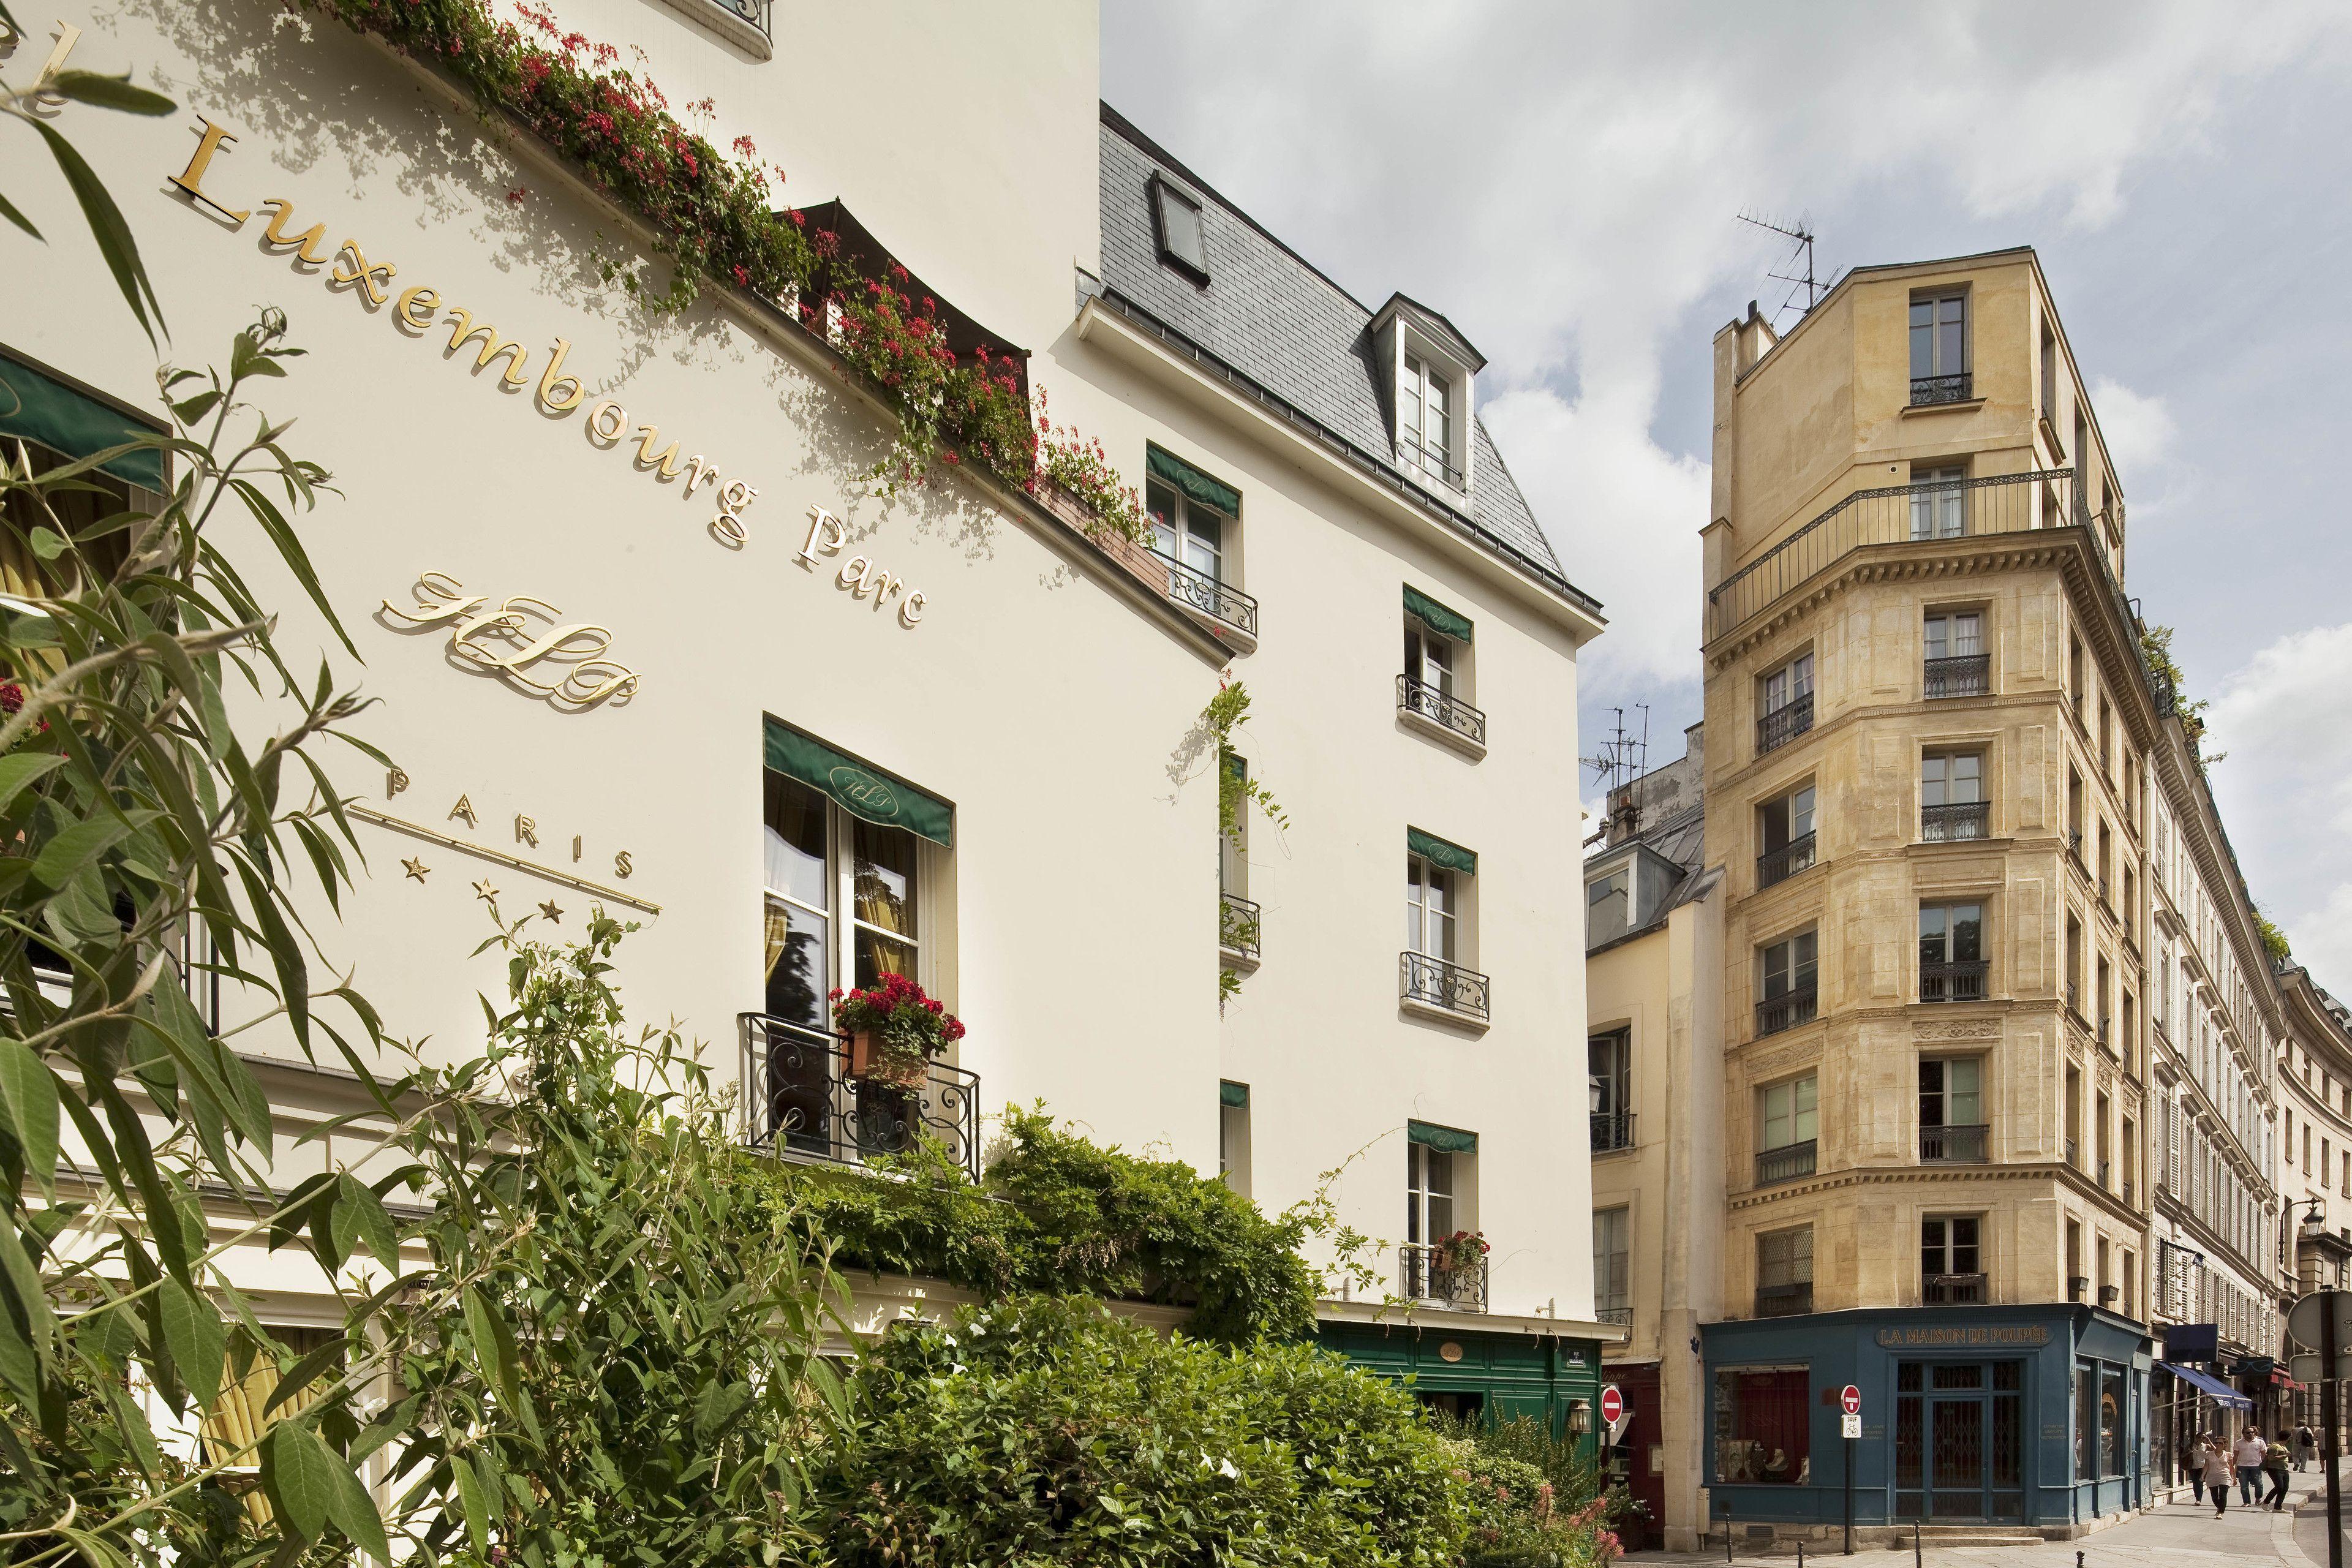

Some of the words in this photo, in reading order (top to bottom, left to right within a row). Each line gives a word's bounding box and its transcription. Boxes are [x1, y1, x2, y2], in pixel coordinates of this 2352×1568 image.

[167, 114, 759, 542] Luxembourg
[797, 503, 927, 623] Parc
[390, 769, 633, 875] PARIS
[1880, 1329, 1902, 1344] LA
[1906, 1329, 1966, 1344] MAISON
[1968, 1328, 1988, 1343] DE
[1991, 1325, 2049, 1343] POUPÉE
